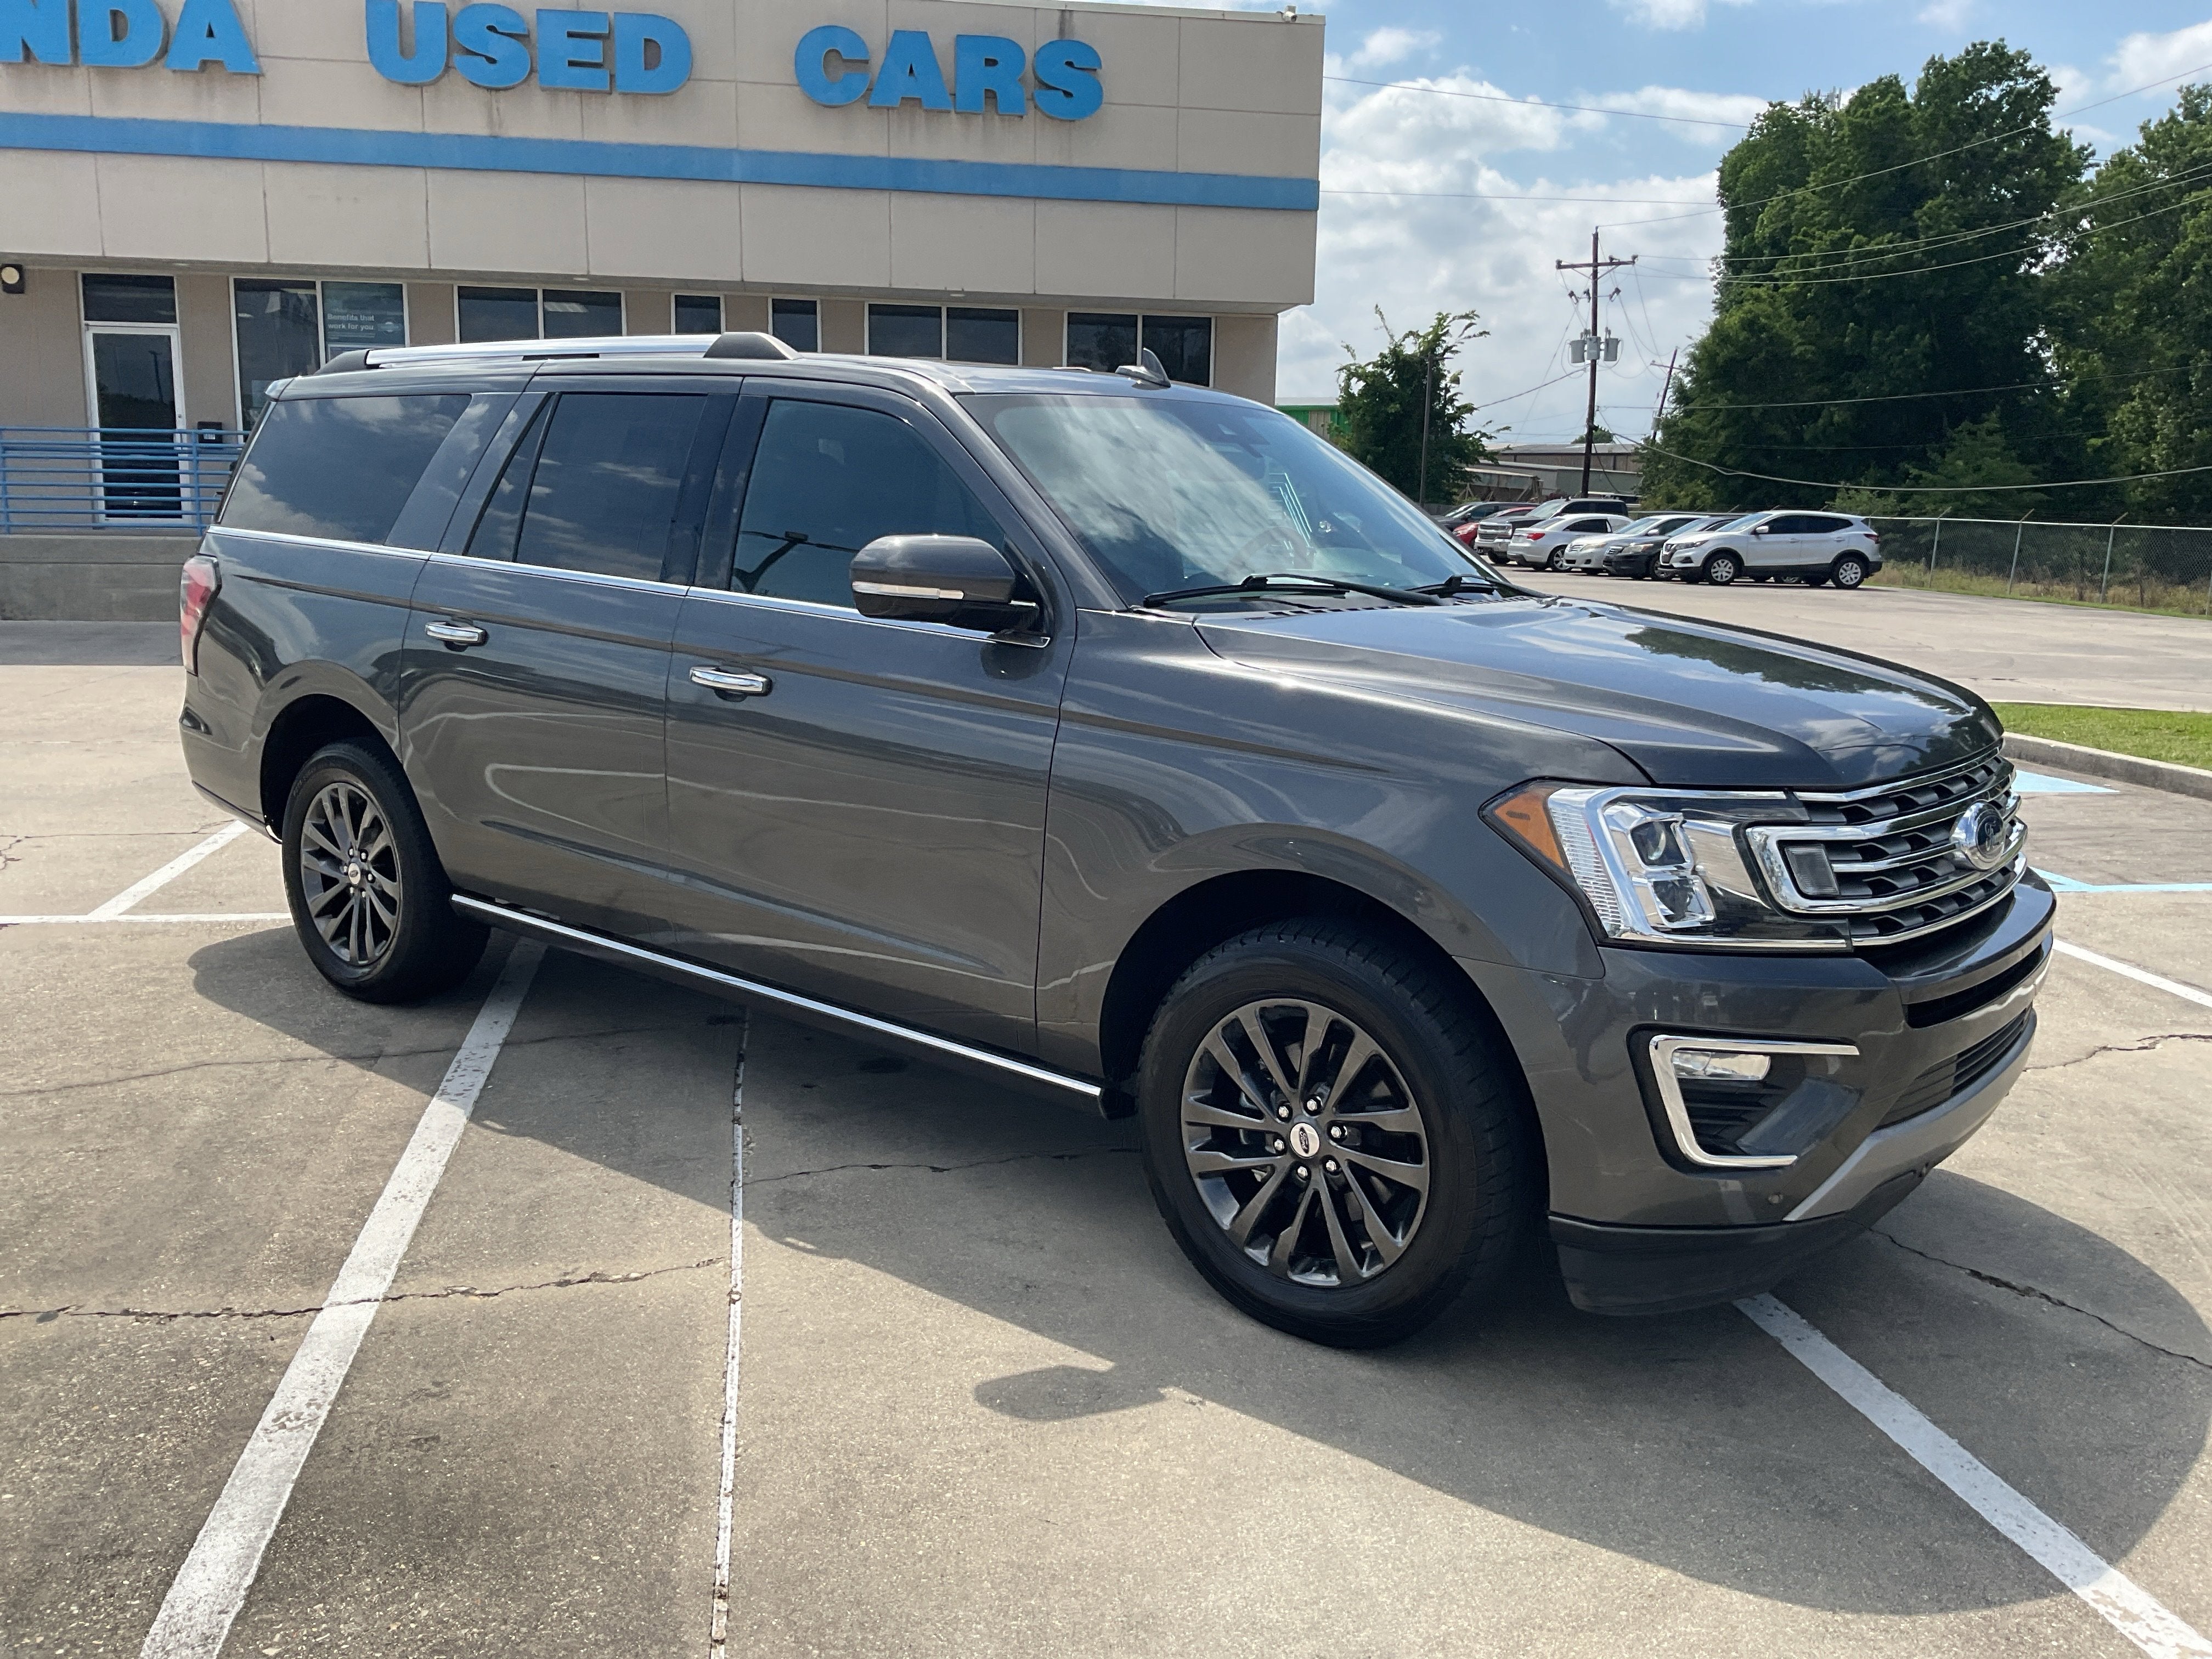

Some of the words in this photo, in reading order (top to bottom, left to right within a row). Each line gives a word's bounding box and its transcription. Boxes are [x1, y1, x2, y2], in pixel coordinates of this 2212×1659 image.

[365, 0, 693, 94] USED
[794, 25, 1103, 121] CARS
[1299, 1130, 1308, 1150] Ford
